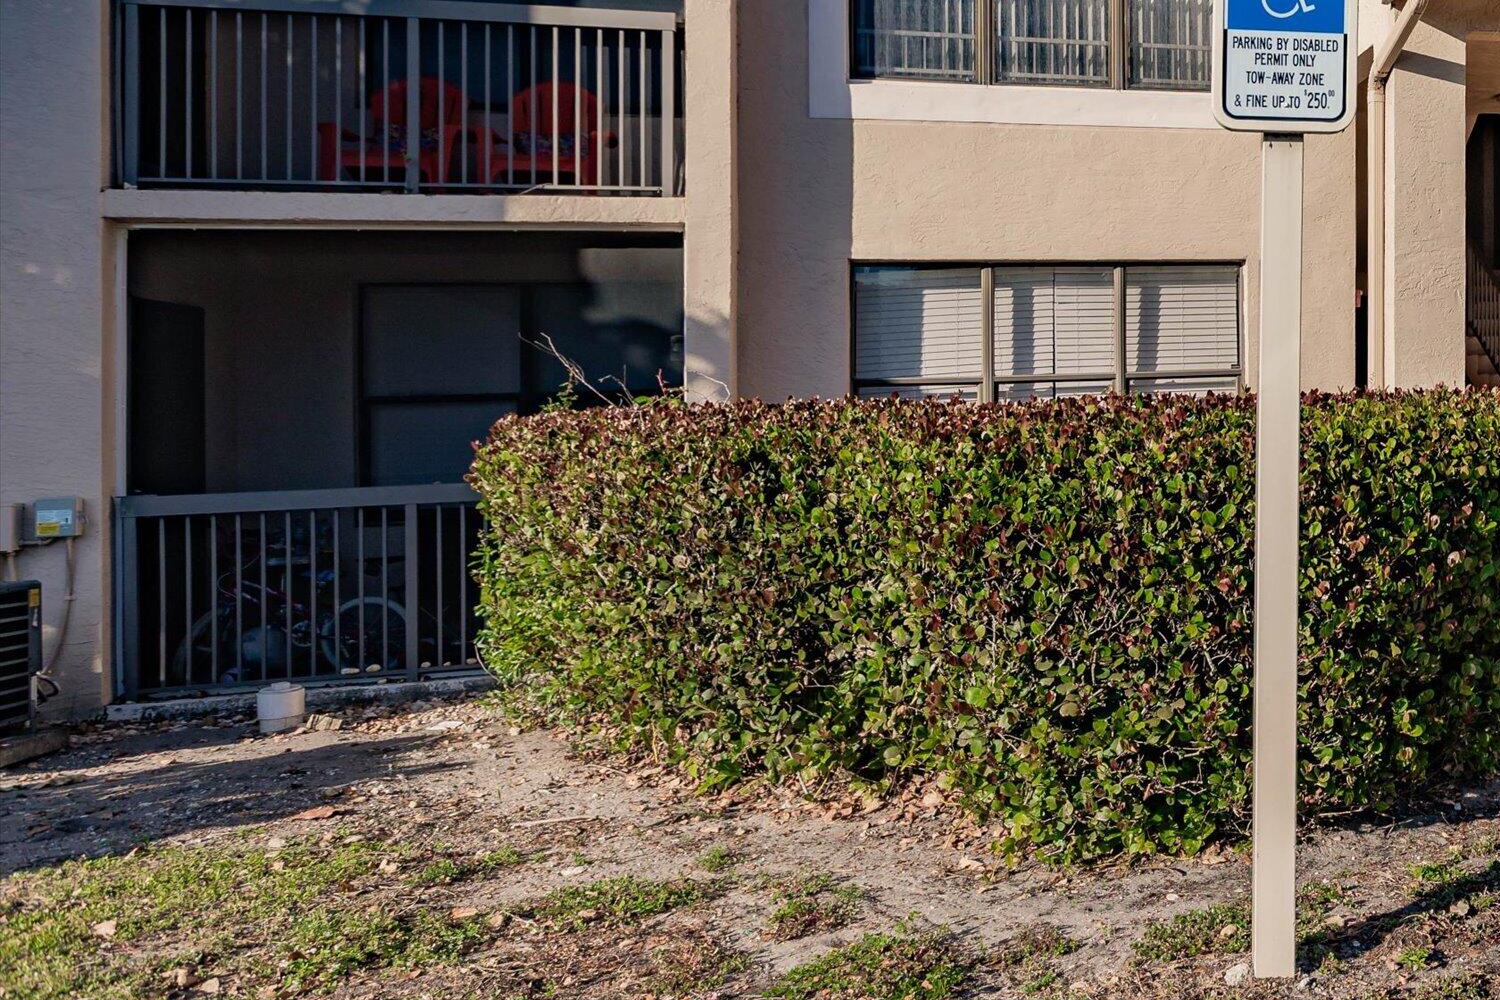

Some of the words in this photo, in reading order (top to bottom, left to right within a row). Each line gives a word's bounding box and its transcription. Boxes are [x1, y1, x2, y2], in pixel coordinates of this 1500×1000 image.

[1232, 36, 1273, 50] PARKING
[1276, 37, 1290, 51] BY
[1293, 38, 1339, 52] DISABLED
[1254, 52, 1289, 66] PERMIT
[1292, 53, 1317, 67] ONLY
[1246, 71, 1295, 85] TOW-AWAY
[1299, 72, 1325, 86] ZONE
[1234, 94, 1242, 107] &
[1246, 94, 1268, 108] FINE
[1272, 95, 1286, 109] UP
[1287, 95, 1301, 109] TO
